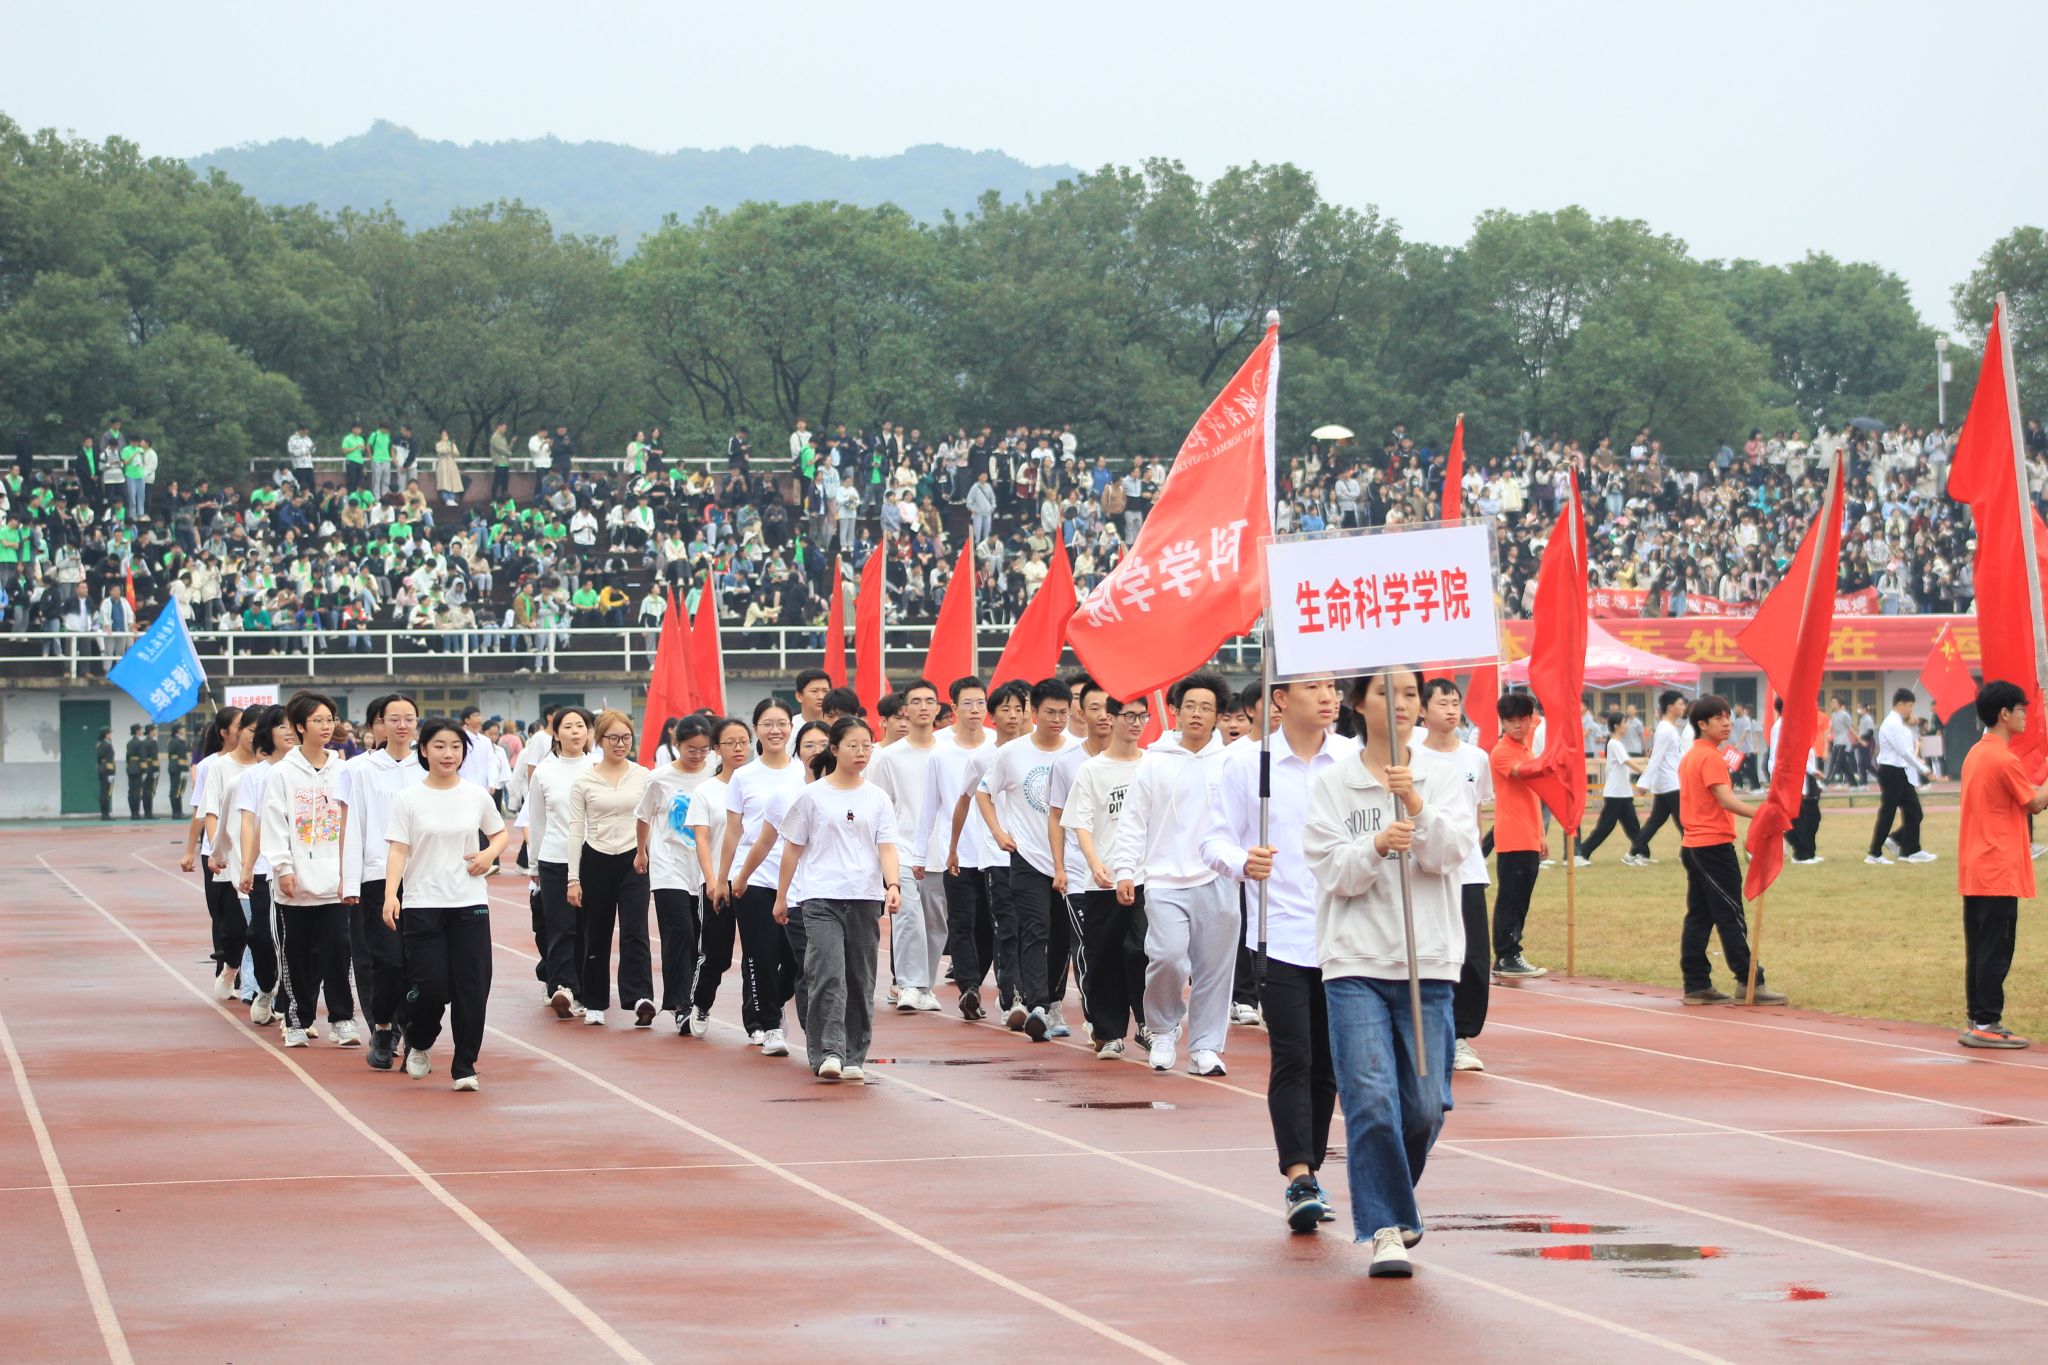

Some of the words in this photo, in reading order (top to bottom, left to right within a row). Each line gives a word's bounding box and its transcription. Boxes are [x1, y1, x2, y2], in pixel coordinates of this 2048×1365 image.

[1295, 566, 1470, 634] 生命科学学院
[1109, 789, 1127, 802] TH
[749, 957, 760, 1011] AUTHENTIC
